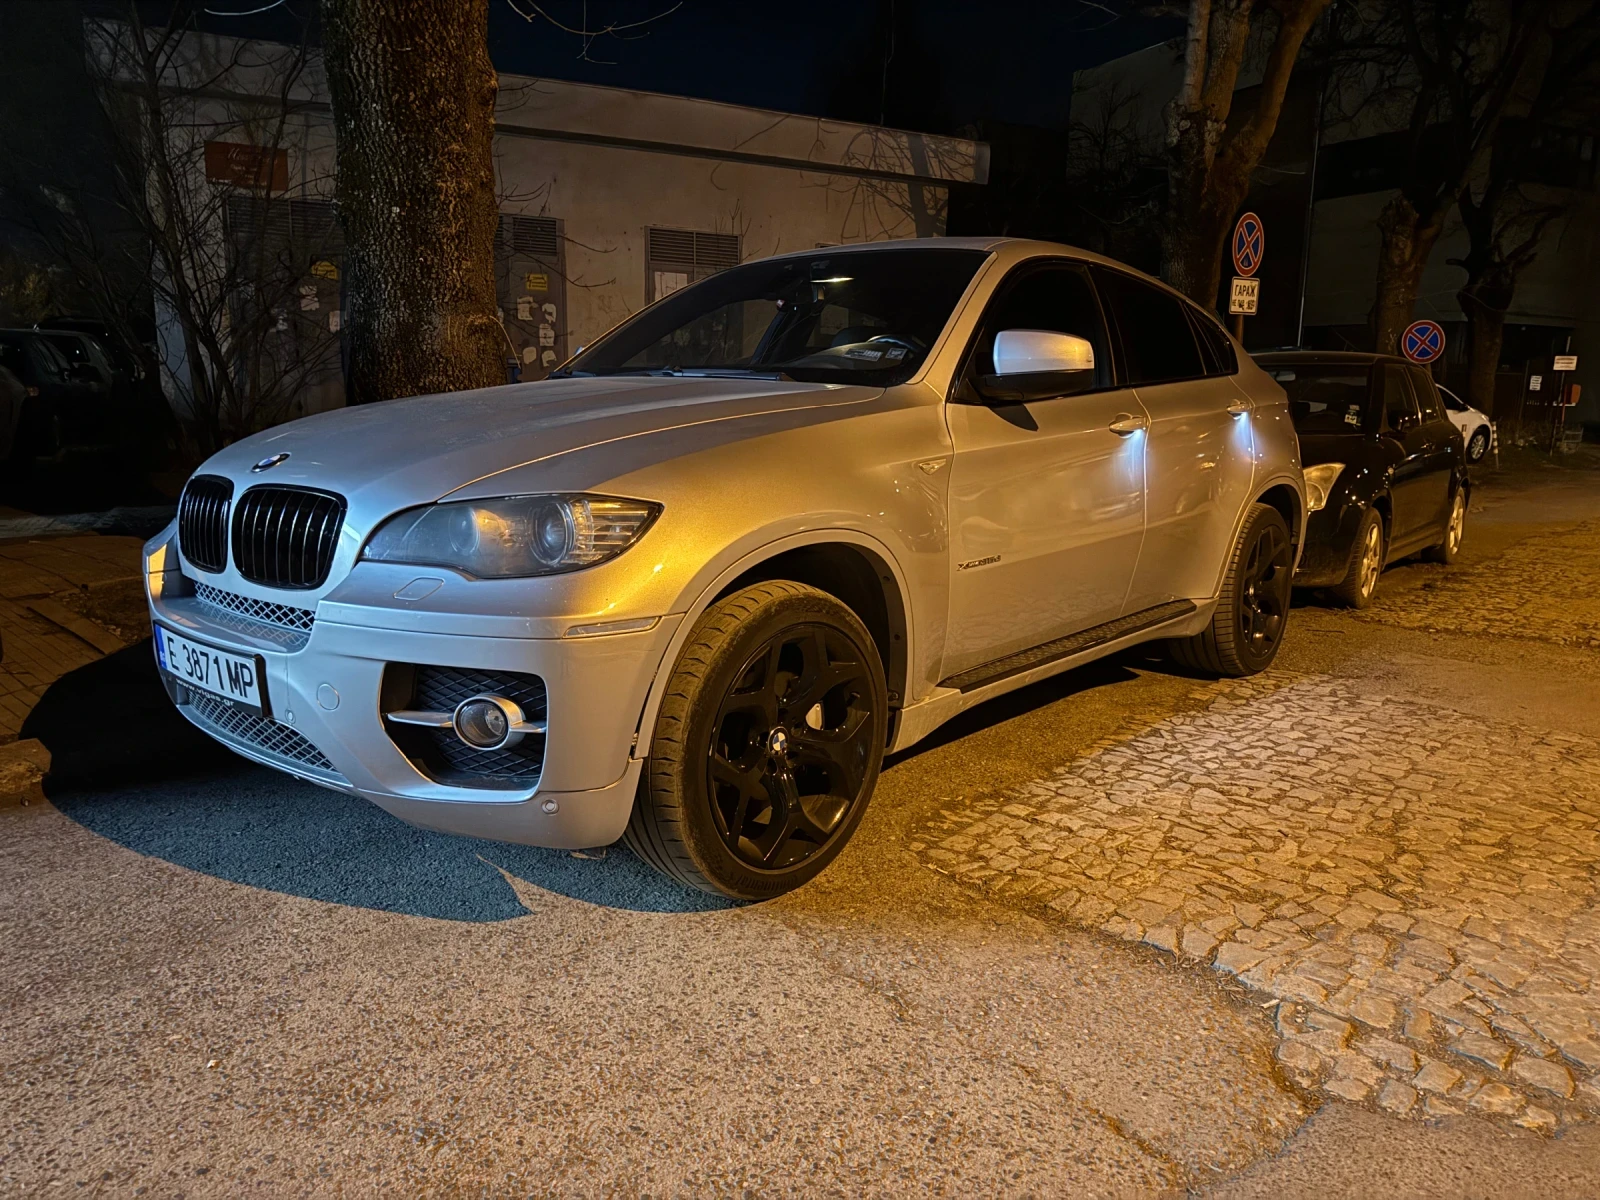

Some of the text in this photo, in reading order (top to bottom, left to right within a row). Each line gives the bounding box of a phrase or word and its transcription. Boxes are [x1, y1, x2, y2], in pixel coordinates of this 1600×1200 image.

[1234, 284, 1257, 297] ГАРАЖ
[167, 636, 254, 699] E 3871 MP
